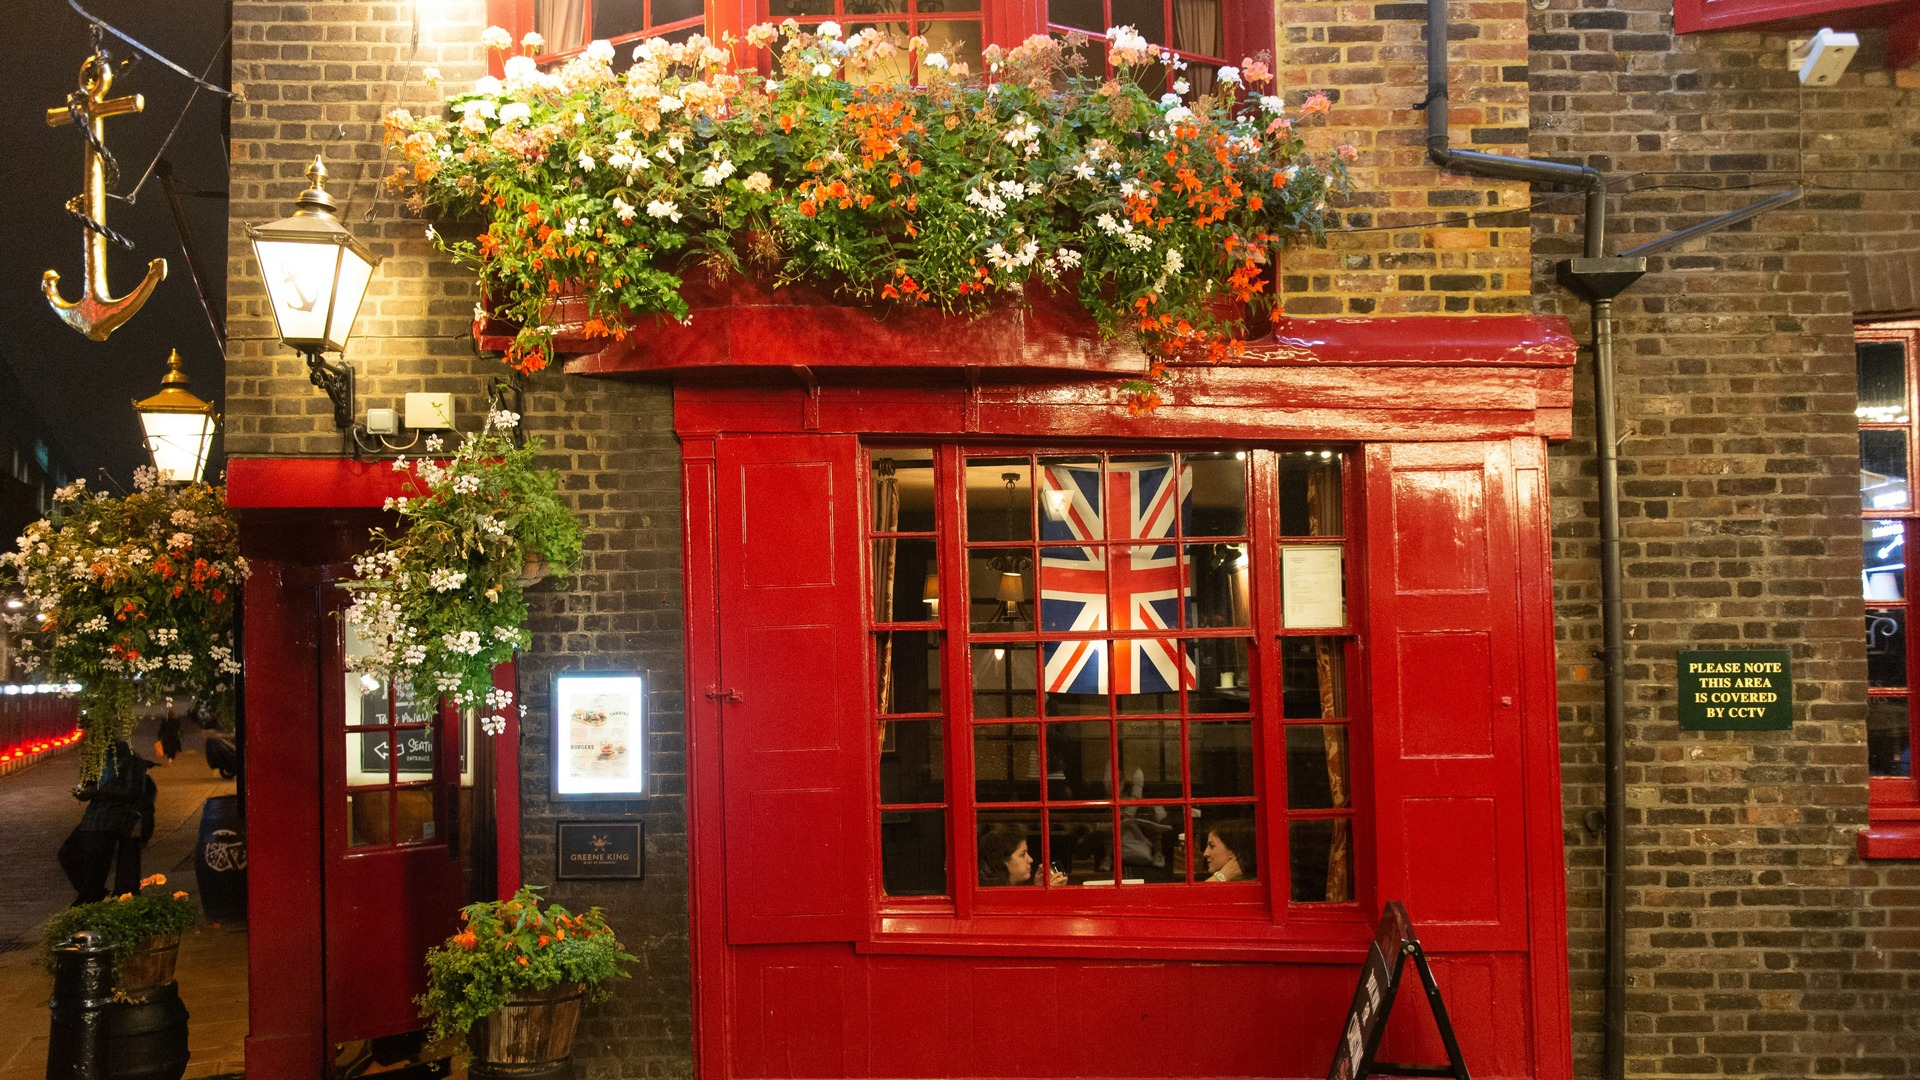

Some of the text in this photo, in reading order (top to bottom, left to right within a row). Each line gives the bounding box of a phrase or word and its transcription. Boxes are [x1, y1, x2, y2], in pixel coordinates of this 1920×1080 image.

[1689, 662, 1782, 673] PLEASE NOTE
[1699, 677, 1772, 688] THIS AREA
[1695, 692, 1778, 703] IS COVERED
[1706, 707, 1766, 718] BY CCTV
[407, 738, 433, 753] SEATI
[570, 853, 629, 861] GREENE KING
